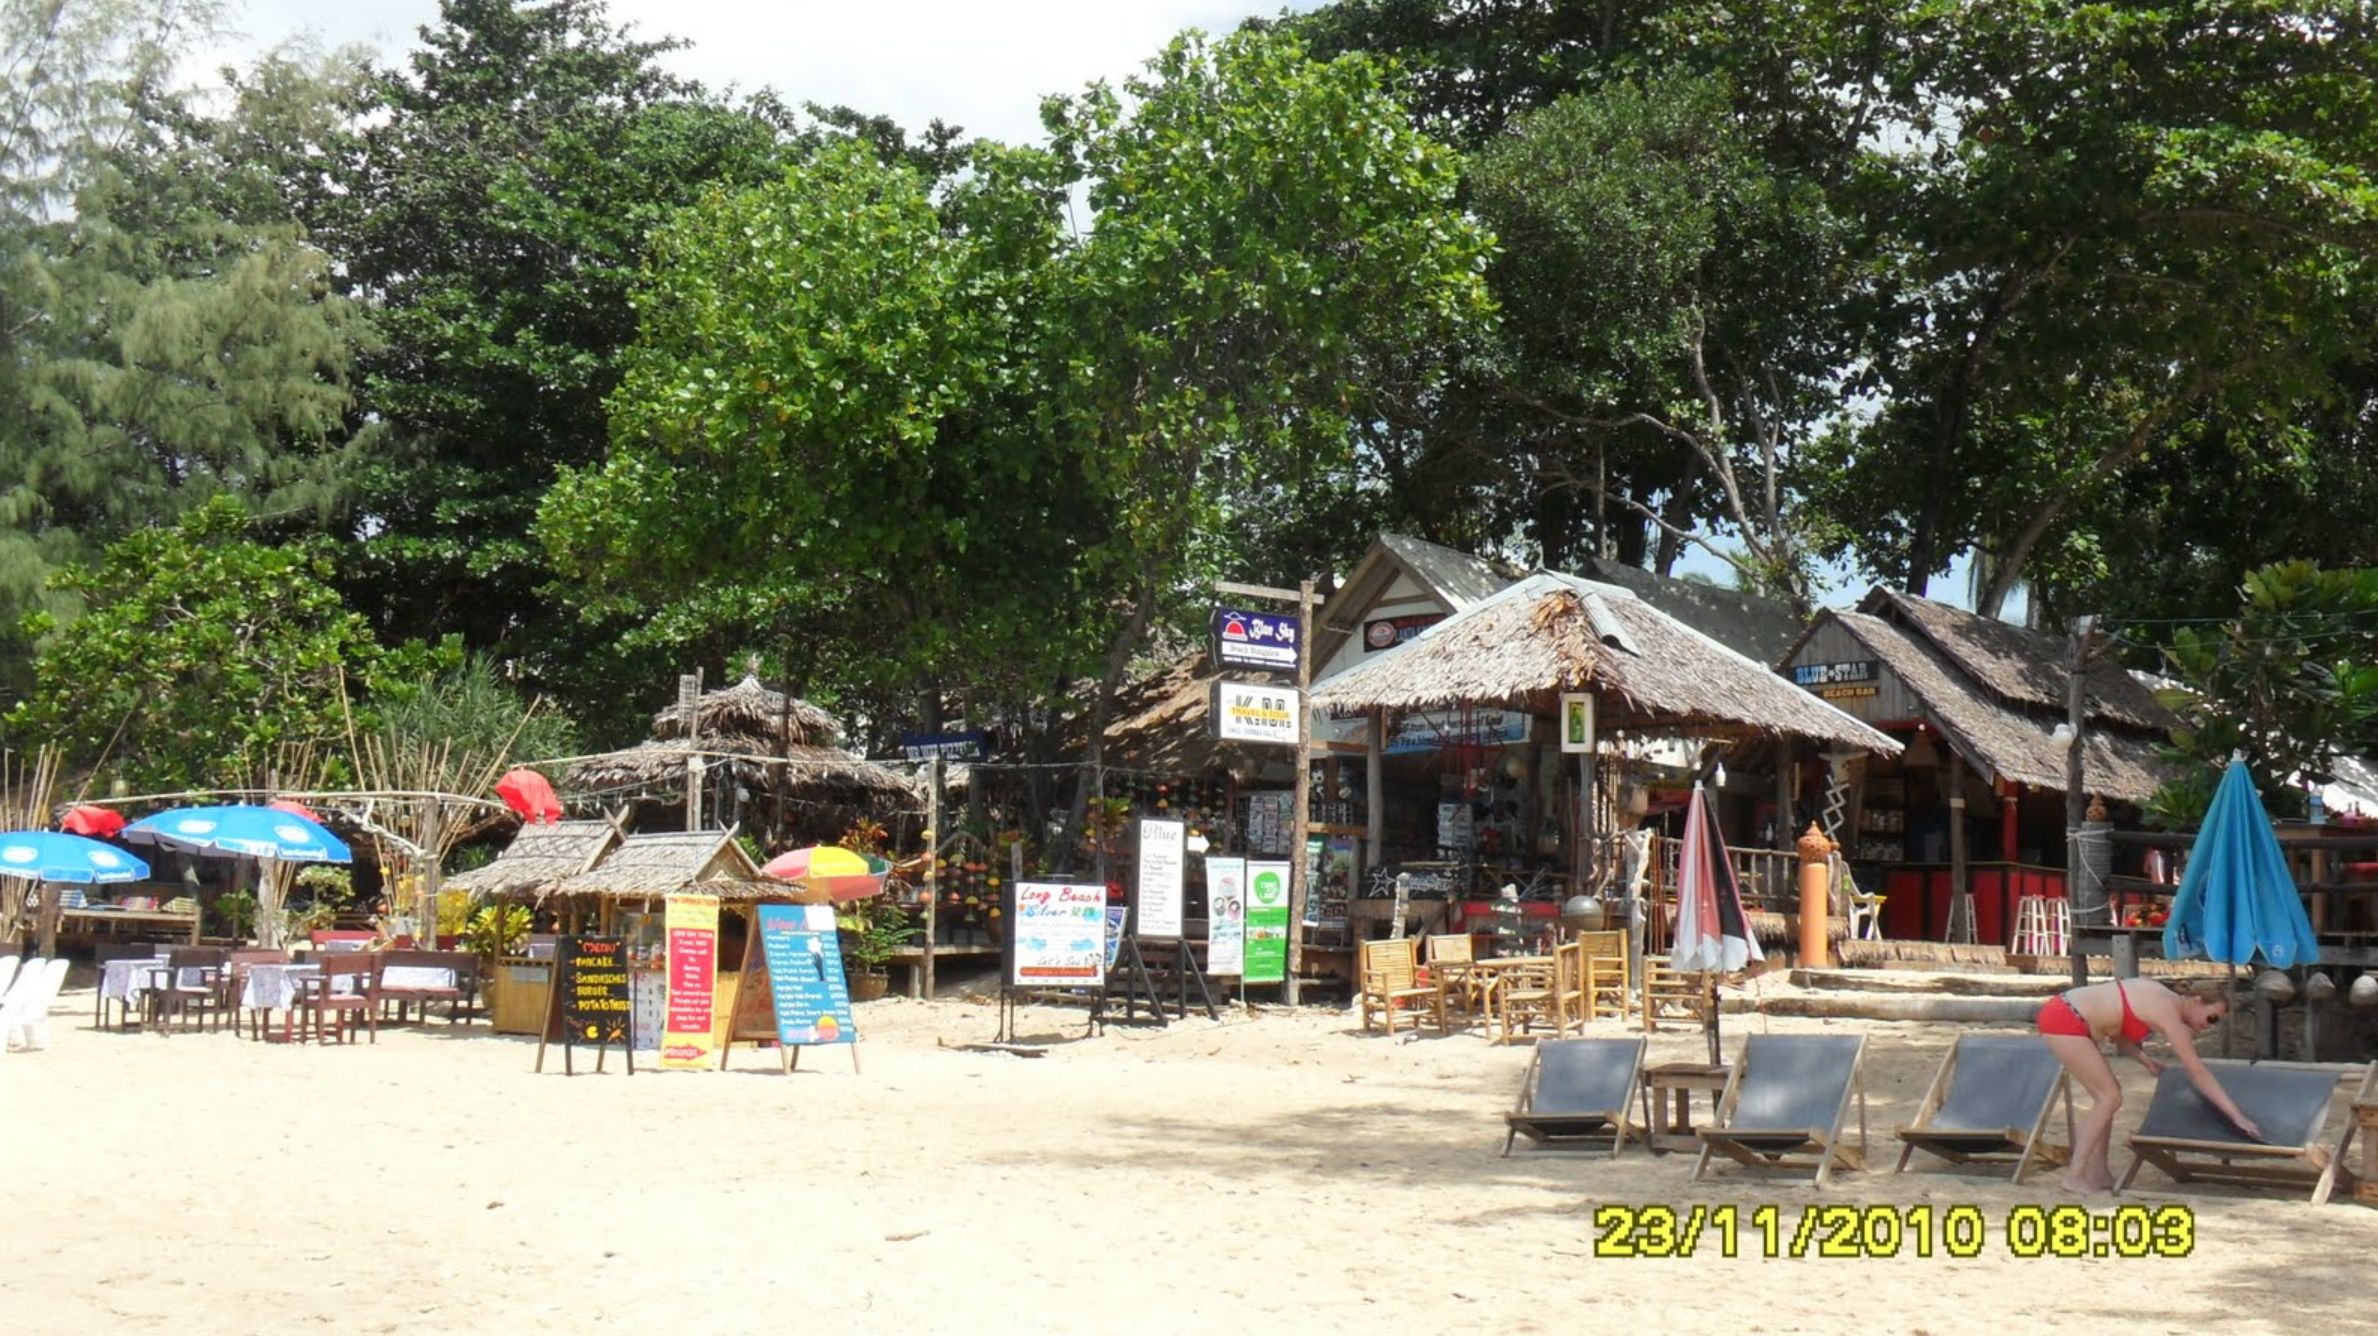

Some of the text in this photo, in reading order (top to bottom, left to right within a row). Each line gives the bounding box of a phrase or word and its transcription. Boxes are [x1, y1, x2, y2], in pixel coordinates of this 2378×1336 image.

[1249, 618, 1295, 643] Blue Sky
[1796, 662, 1868, 684] BLUE STAR
[1823, 687, 1876, 698] BEACH BAR
[1021, 886, 1101, 904] Long Beach
